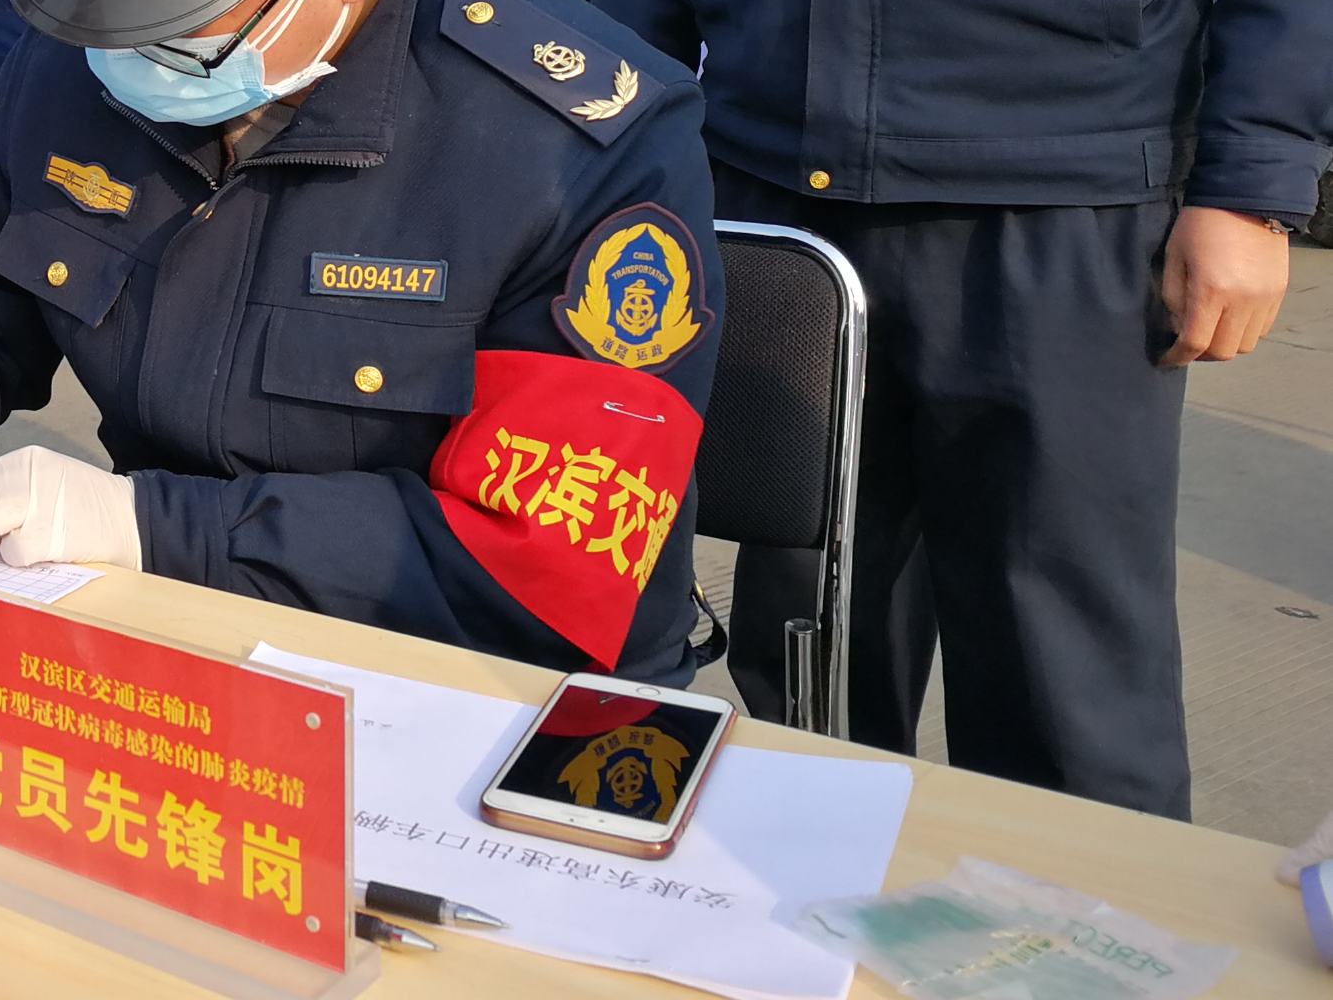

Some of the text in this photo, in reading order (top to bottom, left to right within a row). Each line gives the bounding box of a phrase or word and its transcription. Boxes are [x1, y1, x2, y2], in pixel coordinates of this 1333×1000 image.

[322, 263, 436, 293] 61094147
[19, 651, 213, 736] 汉滨区交通运输局
